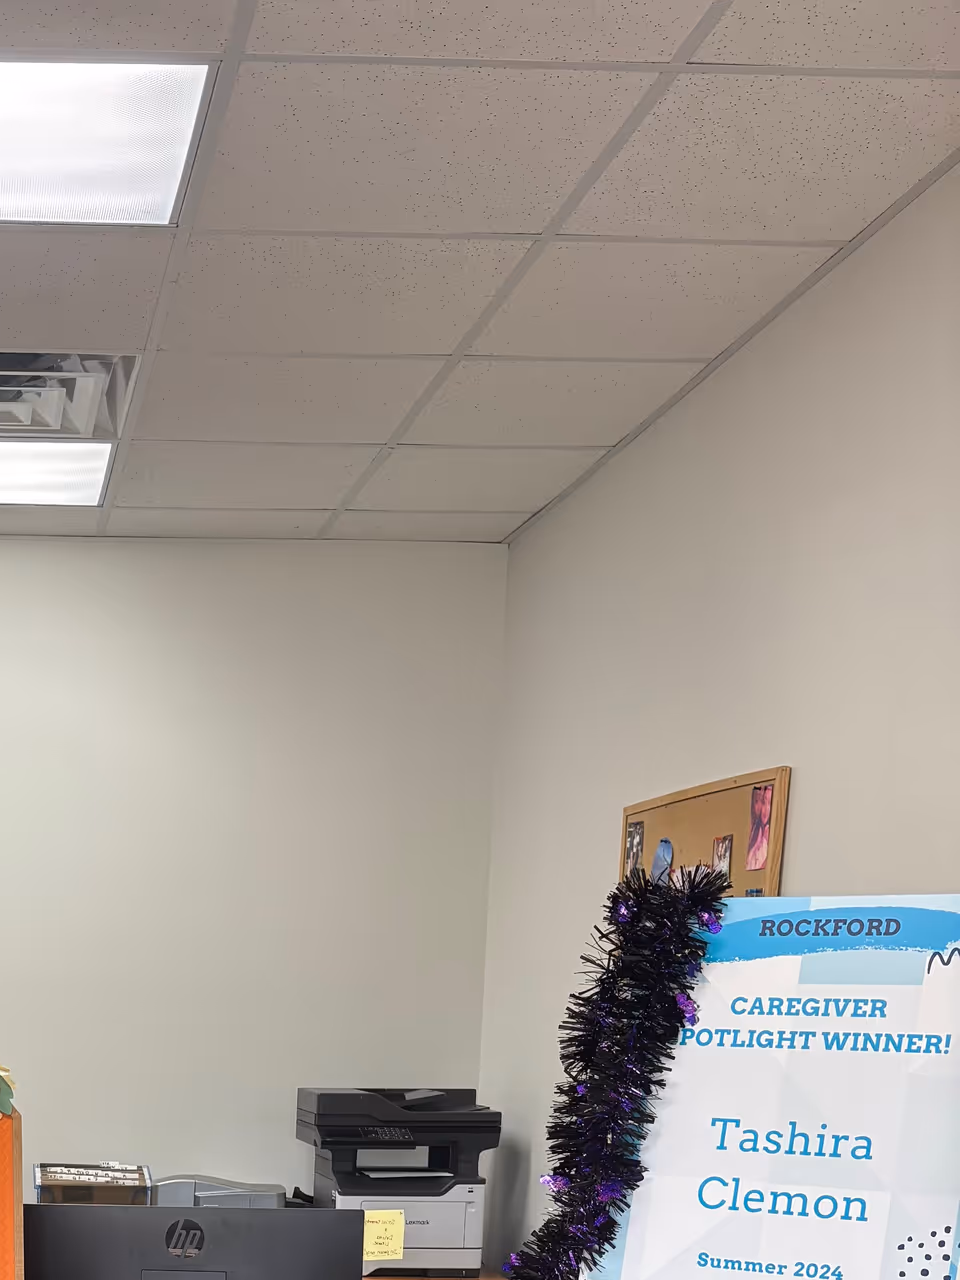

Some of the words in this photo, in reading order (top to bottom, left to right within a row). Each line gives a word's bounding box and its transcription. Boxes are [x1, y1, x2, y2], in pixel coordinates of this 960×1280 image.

[759, 918, 901, 937] ROCKFORD
[730, 996, 888, 1018] CAREGIVER
[679, 1028, 816, 1050] POTLIGHT
[821, 1032, 952, 1055] WINNER!
[711, 1117, 873, 1160] Tashira
[697, 1176, 868, 1222] Clemon
[168, 1219, 202, 1258] hp
[696, 1252, 788, 1275] Summer
[793, 1262, 843, 1280] 2024
